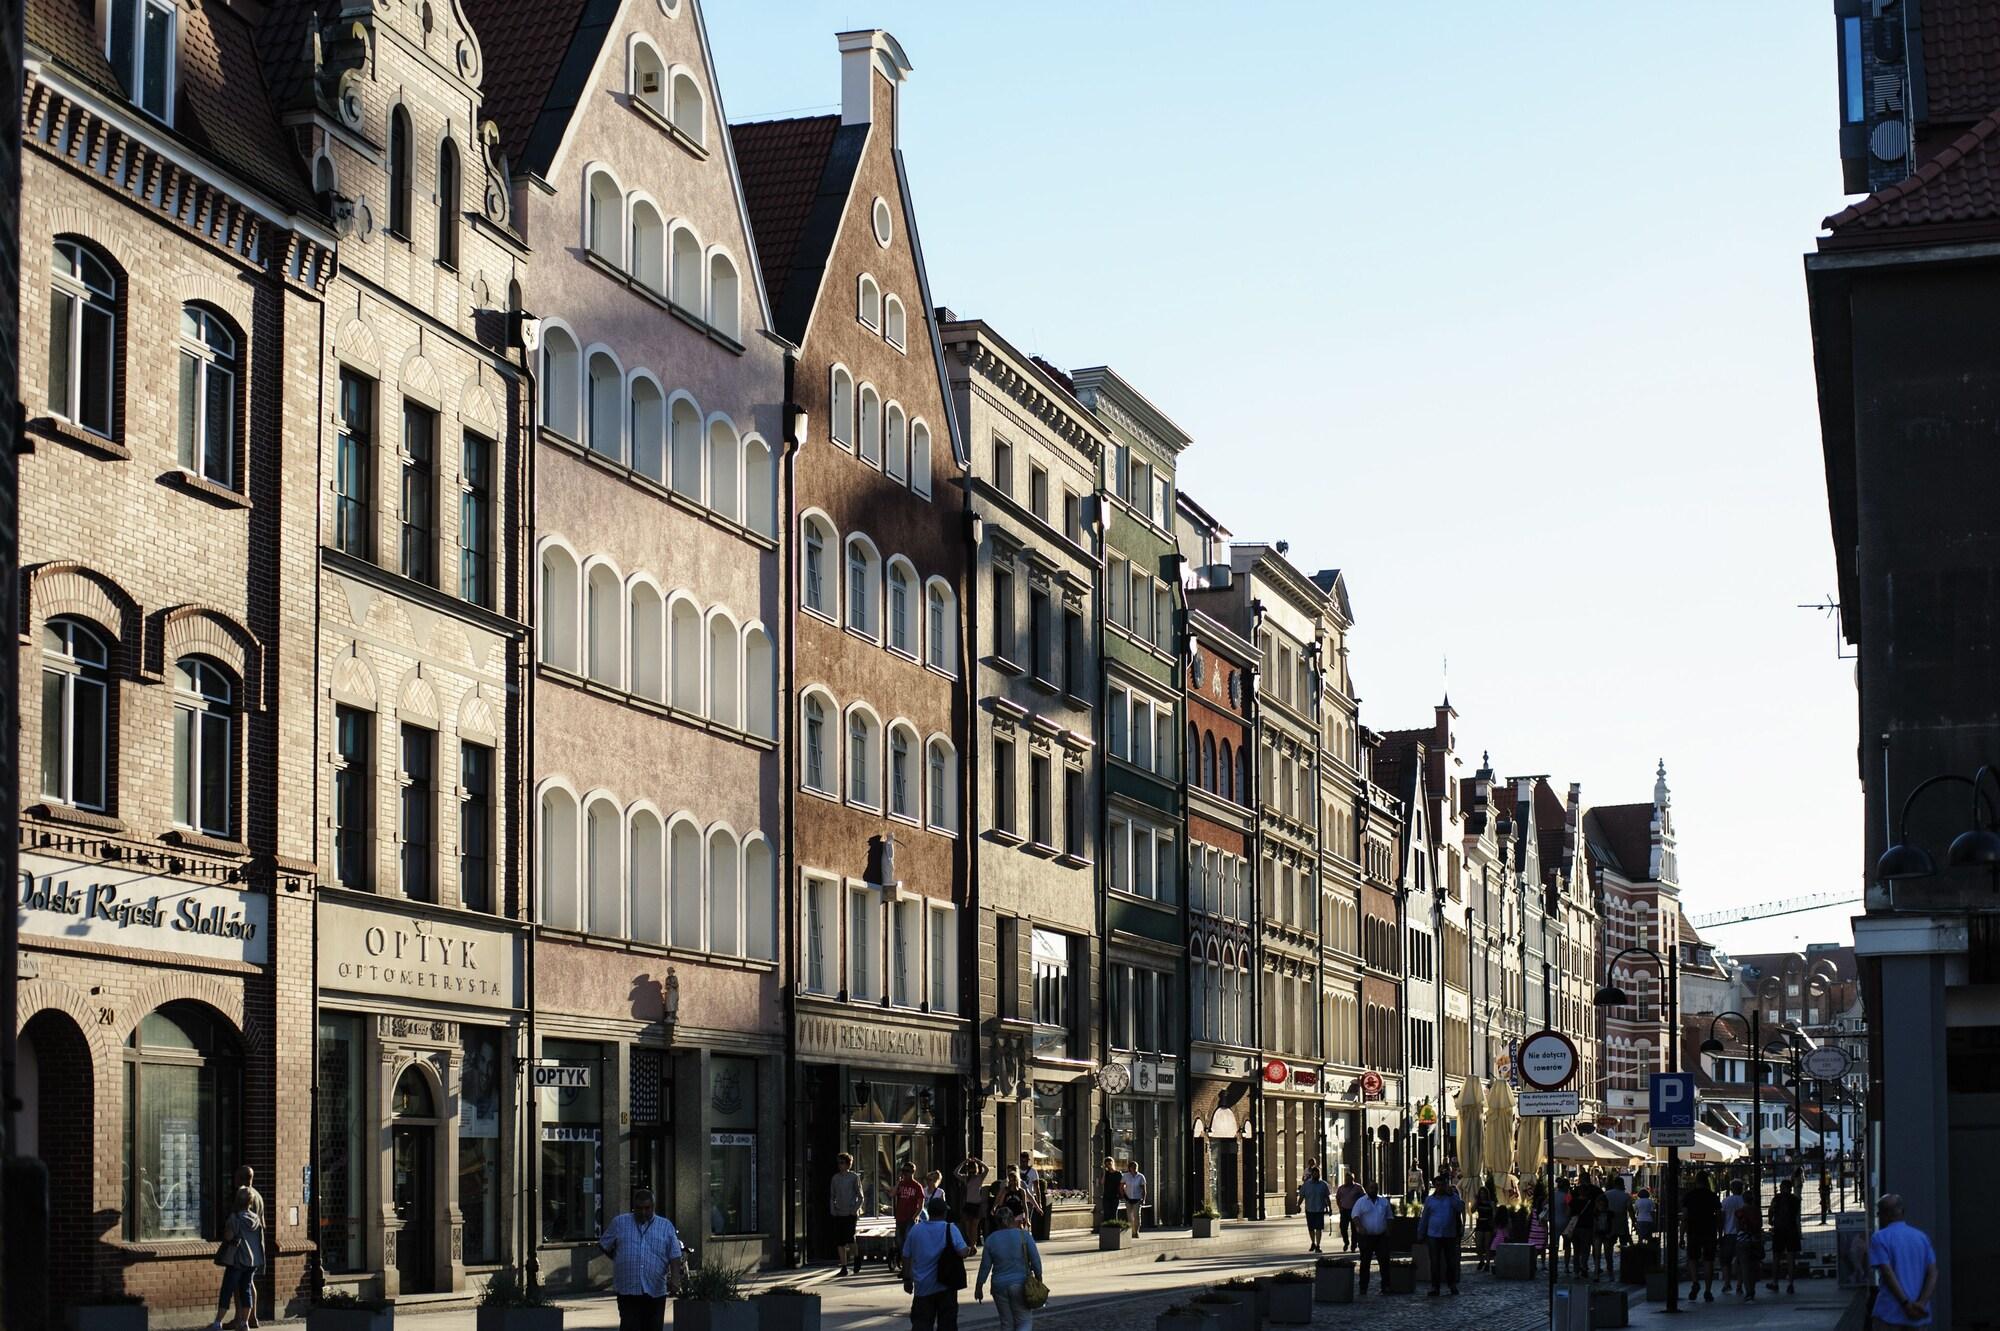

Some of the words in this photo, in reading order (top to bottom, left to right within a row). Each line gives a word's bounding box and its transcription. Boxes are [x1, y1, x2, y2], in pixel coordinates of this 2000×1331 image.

[87, 883, 167, 929] Rejestr
[365, 926, 479, 970] OPTYK
[18, 959, 39, 973] EWNA
[338, 962, 501, 997] OPTOMETRYSTA
[99, 1007, 115, 1026] 20
[839, 1024, 925, 1057] RESTAURACJA
[1528, 1052, 1540, 1060] Nie
[1542, 1051, 1567, 1061] dotyczy
[536, 1068, 587, 1085] OPTYK
[1659, 1078, 1684, 1113] P
